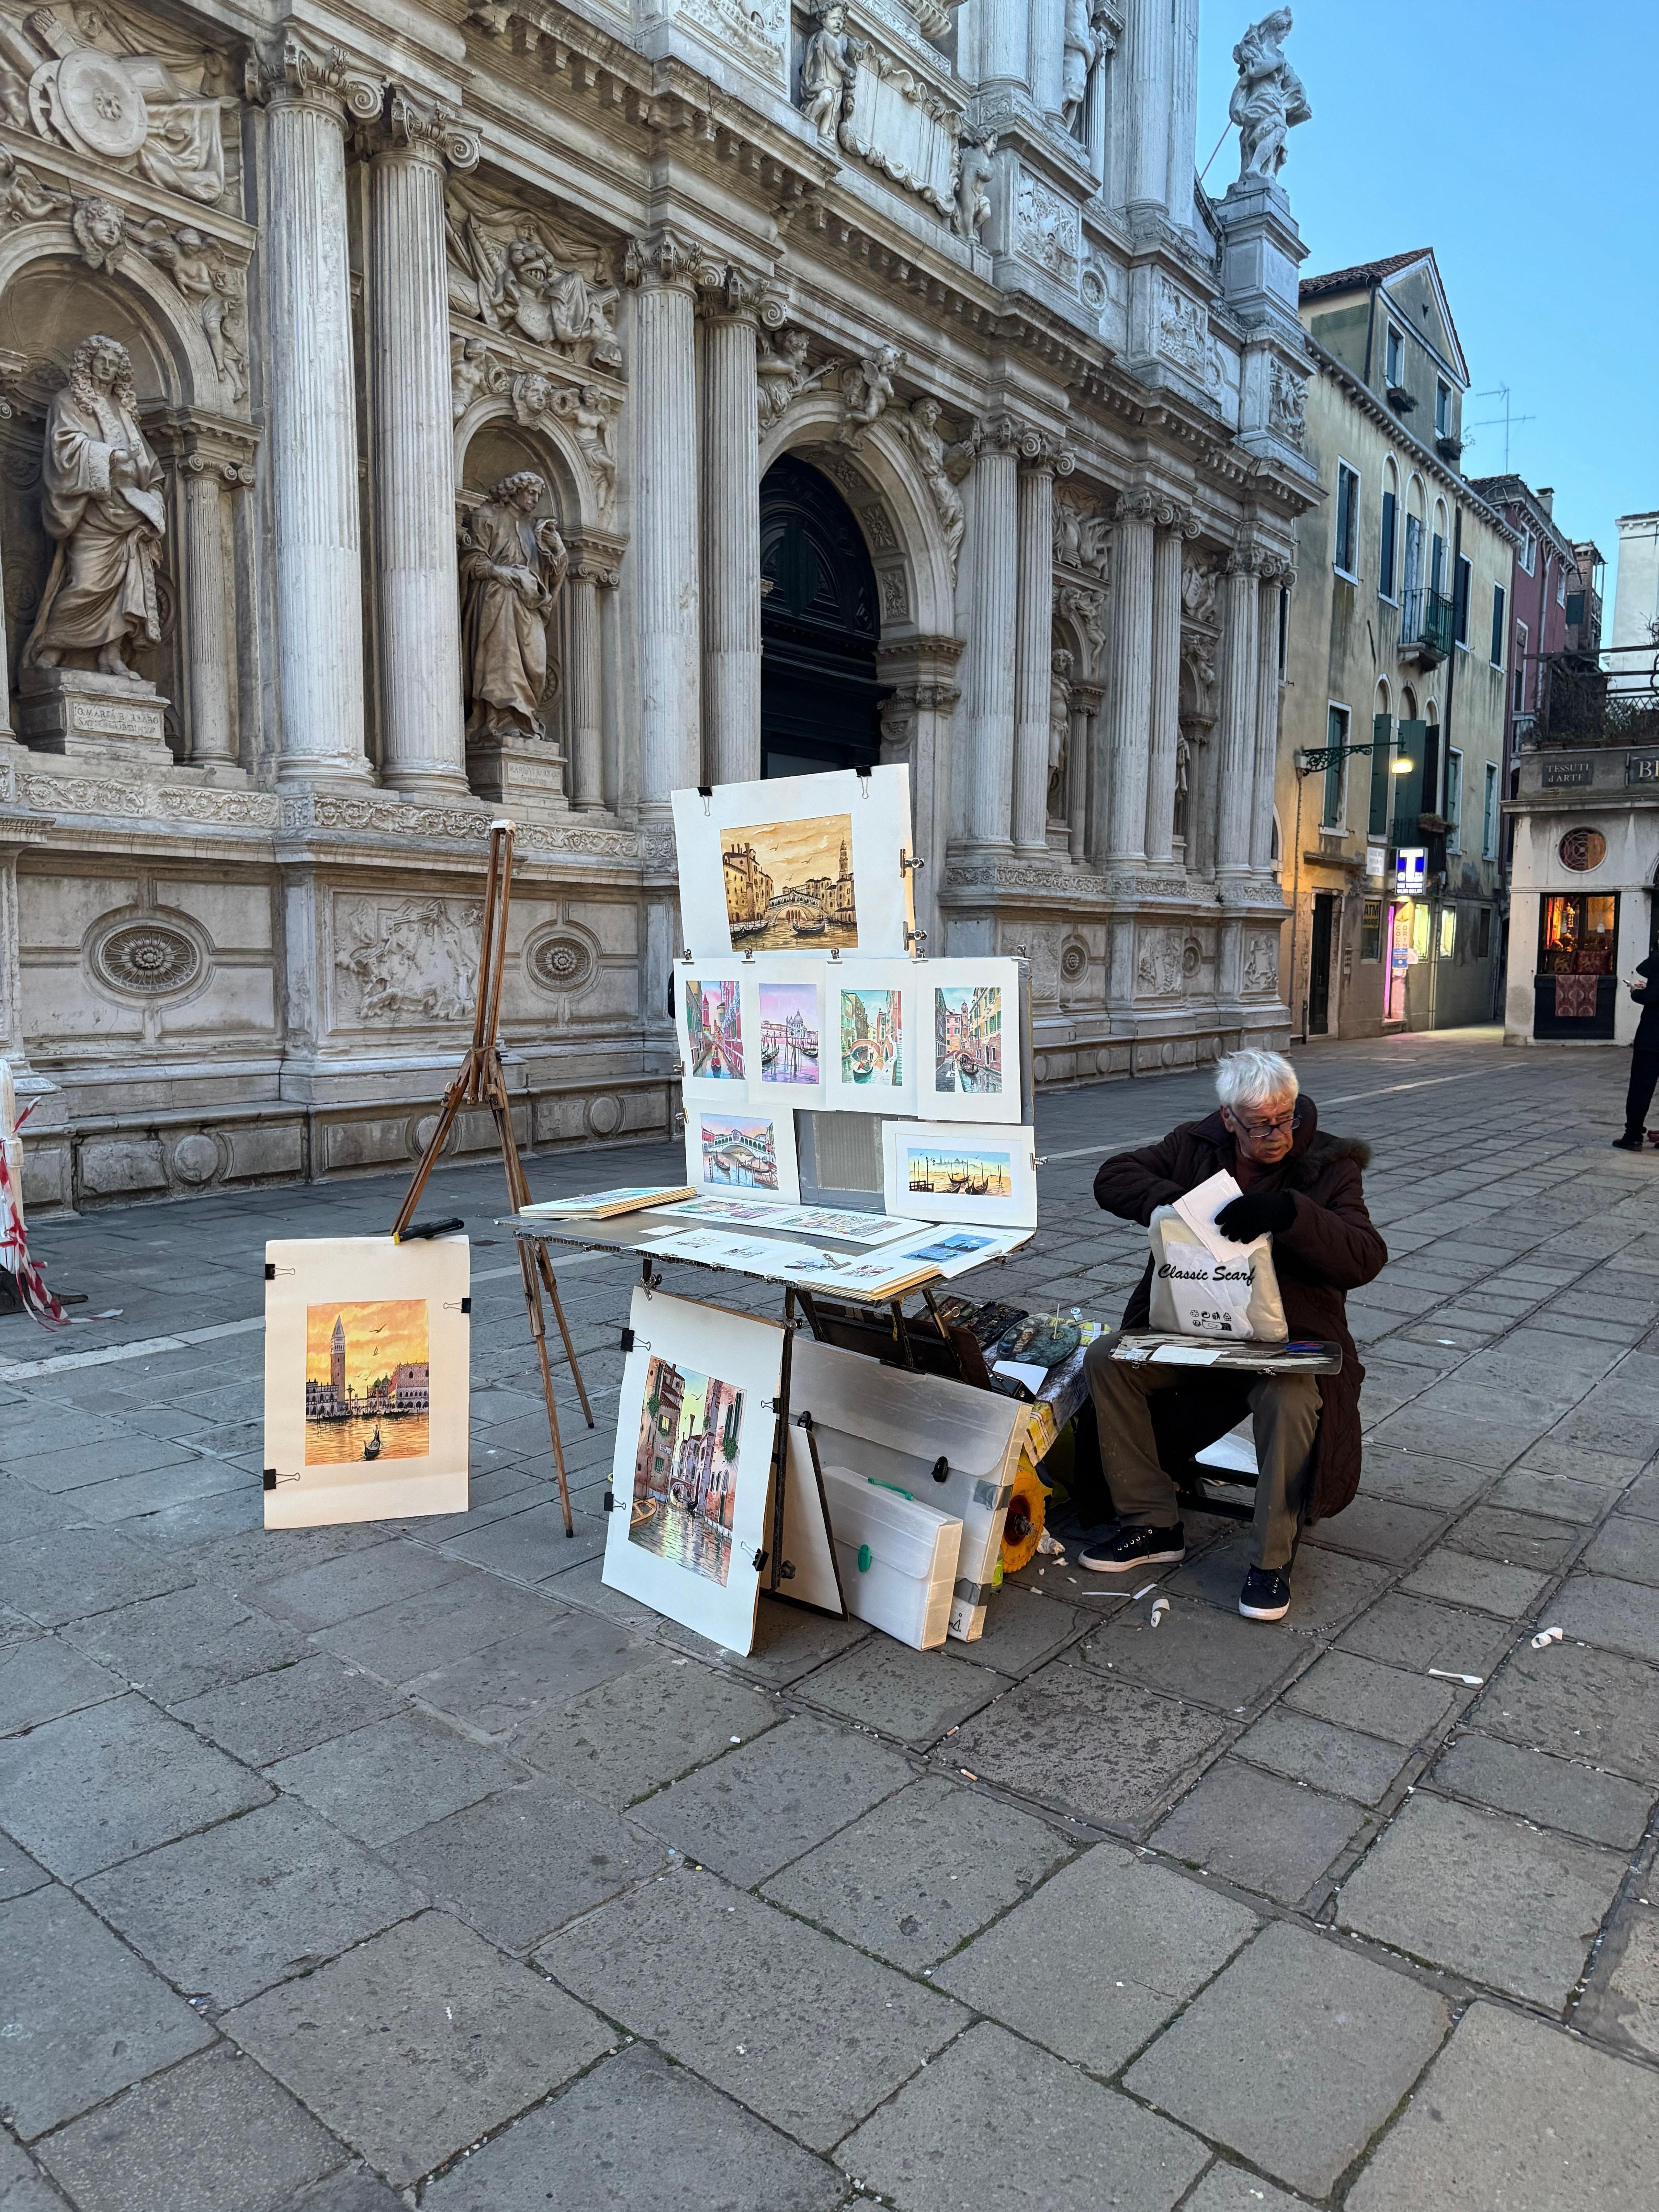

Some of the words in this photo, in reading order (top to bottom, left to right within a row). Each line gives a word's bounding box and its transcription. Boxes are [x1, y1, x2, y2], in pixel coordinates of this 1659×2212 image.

[1546, 764, 1589, 773] TESSUTI
[1556, 774, 1584, 782] ARTE
[1400, 849, 1424, 882] T
[1364, 904, 1379, 916] ATM
[1158, 1264, 1209, 1280] Classic
[1212, 1265, 1256, 1286] Scarf
